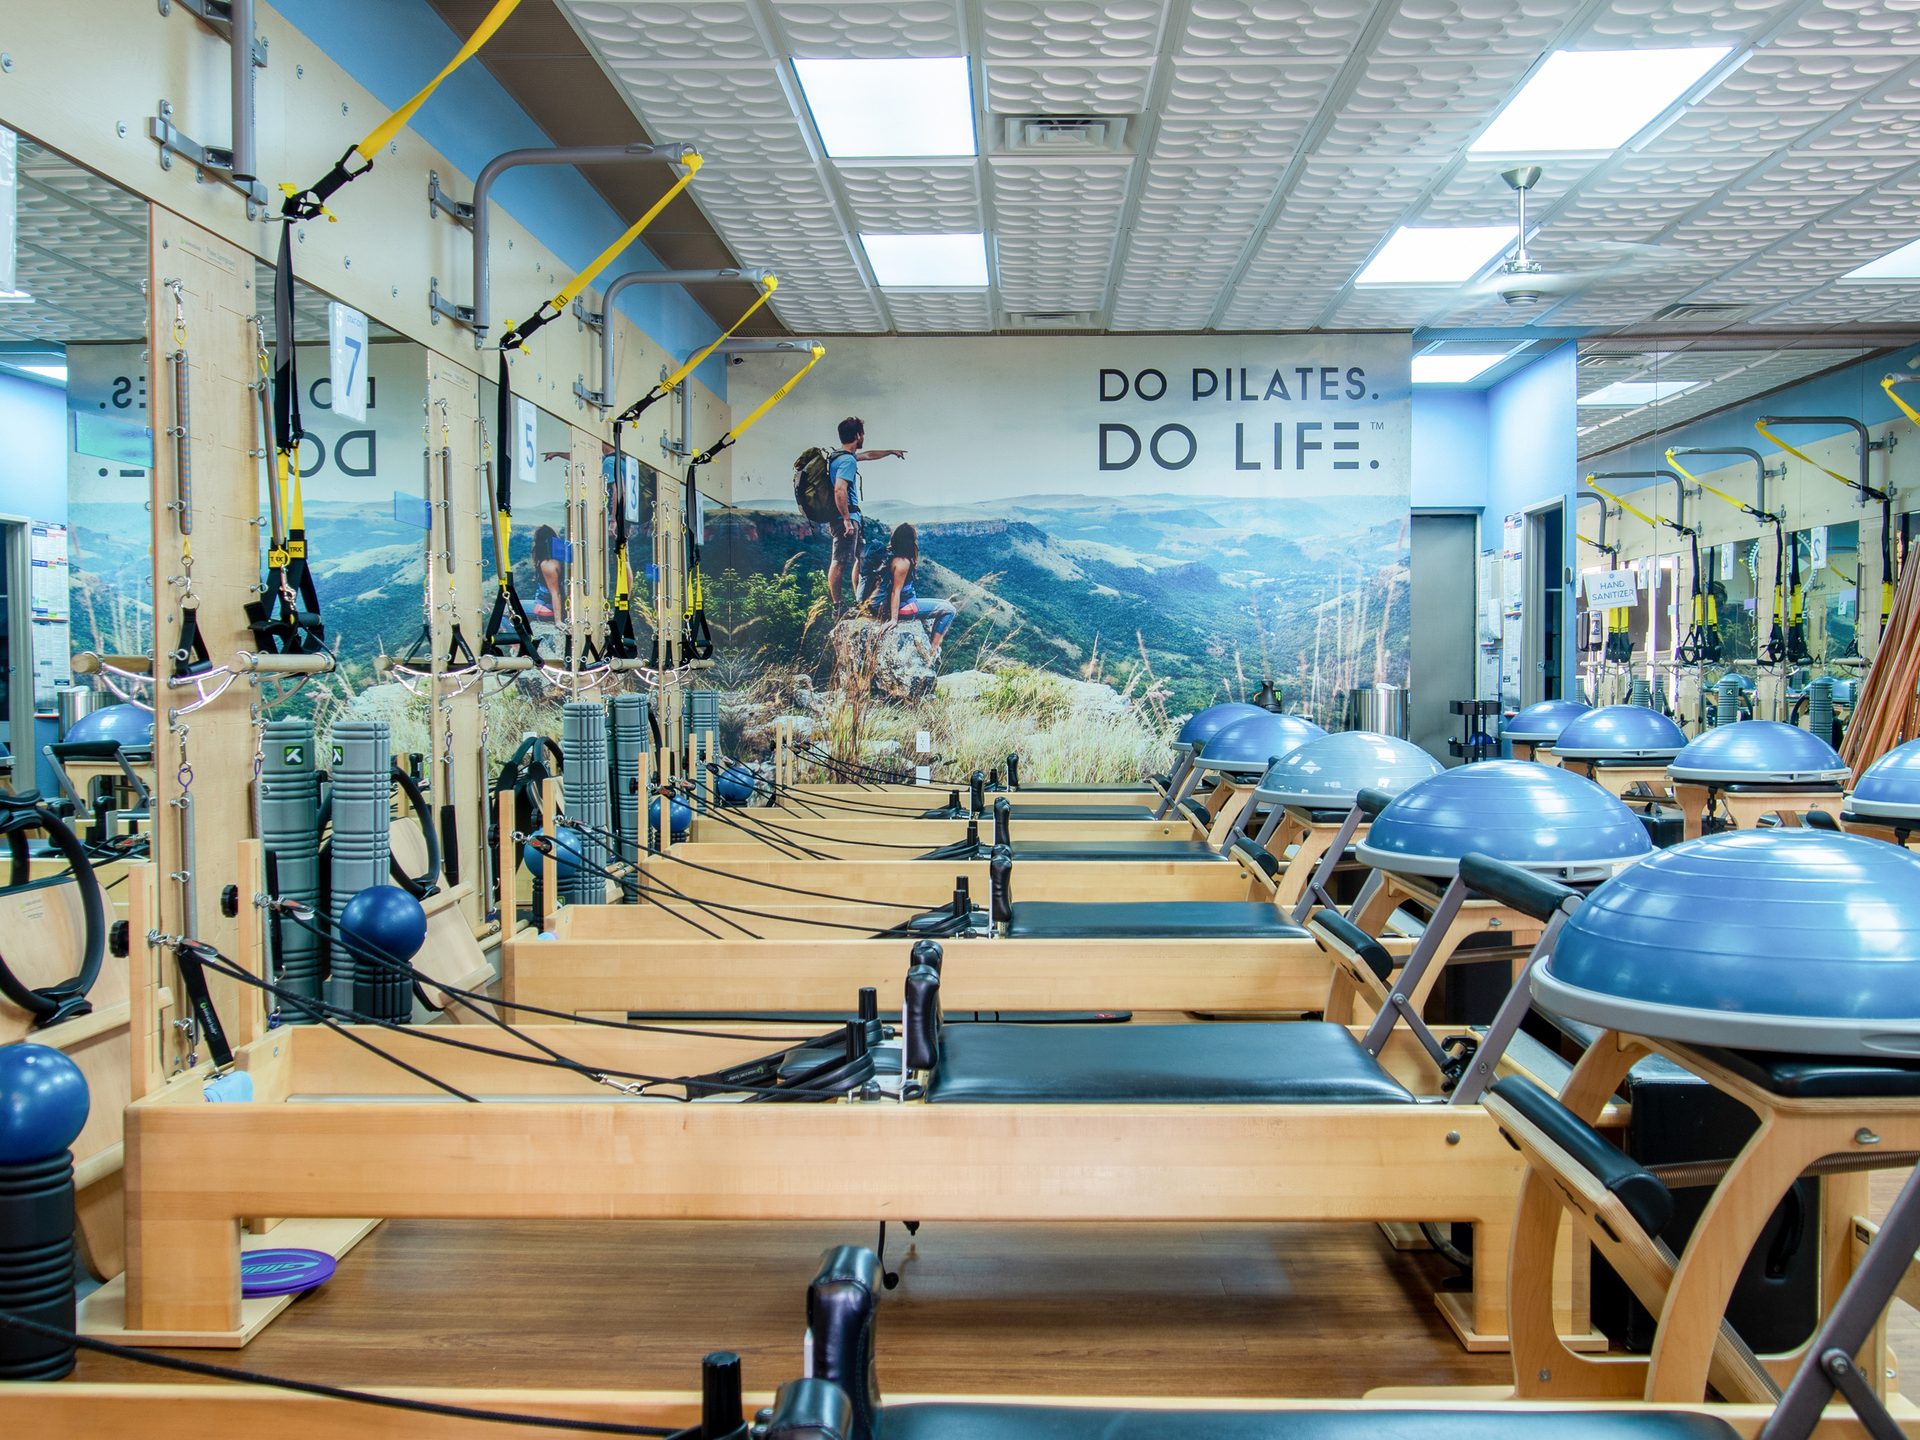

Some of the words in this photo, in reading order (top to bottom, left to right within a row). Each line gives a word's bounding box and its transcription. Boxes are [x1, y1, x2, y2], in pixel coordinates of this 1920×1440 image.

[344, 336, 362, 398] 7
[1100, 368, 1167, 401] DO
[1193, 367, 1378, 401] PILATES.
[525, 423, 534, 468] 5
[1099, 423, 1197, 470] DO
[1236, 422, 1379, 470] LIFE.
[630, 475, 637, 509] 3
[1592, 588, 1634, 601] SANITIZER
[1600, 580, 1625, 590] HAND
